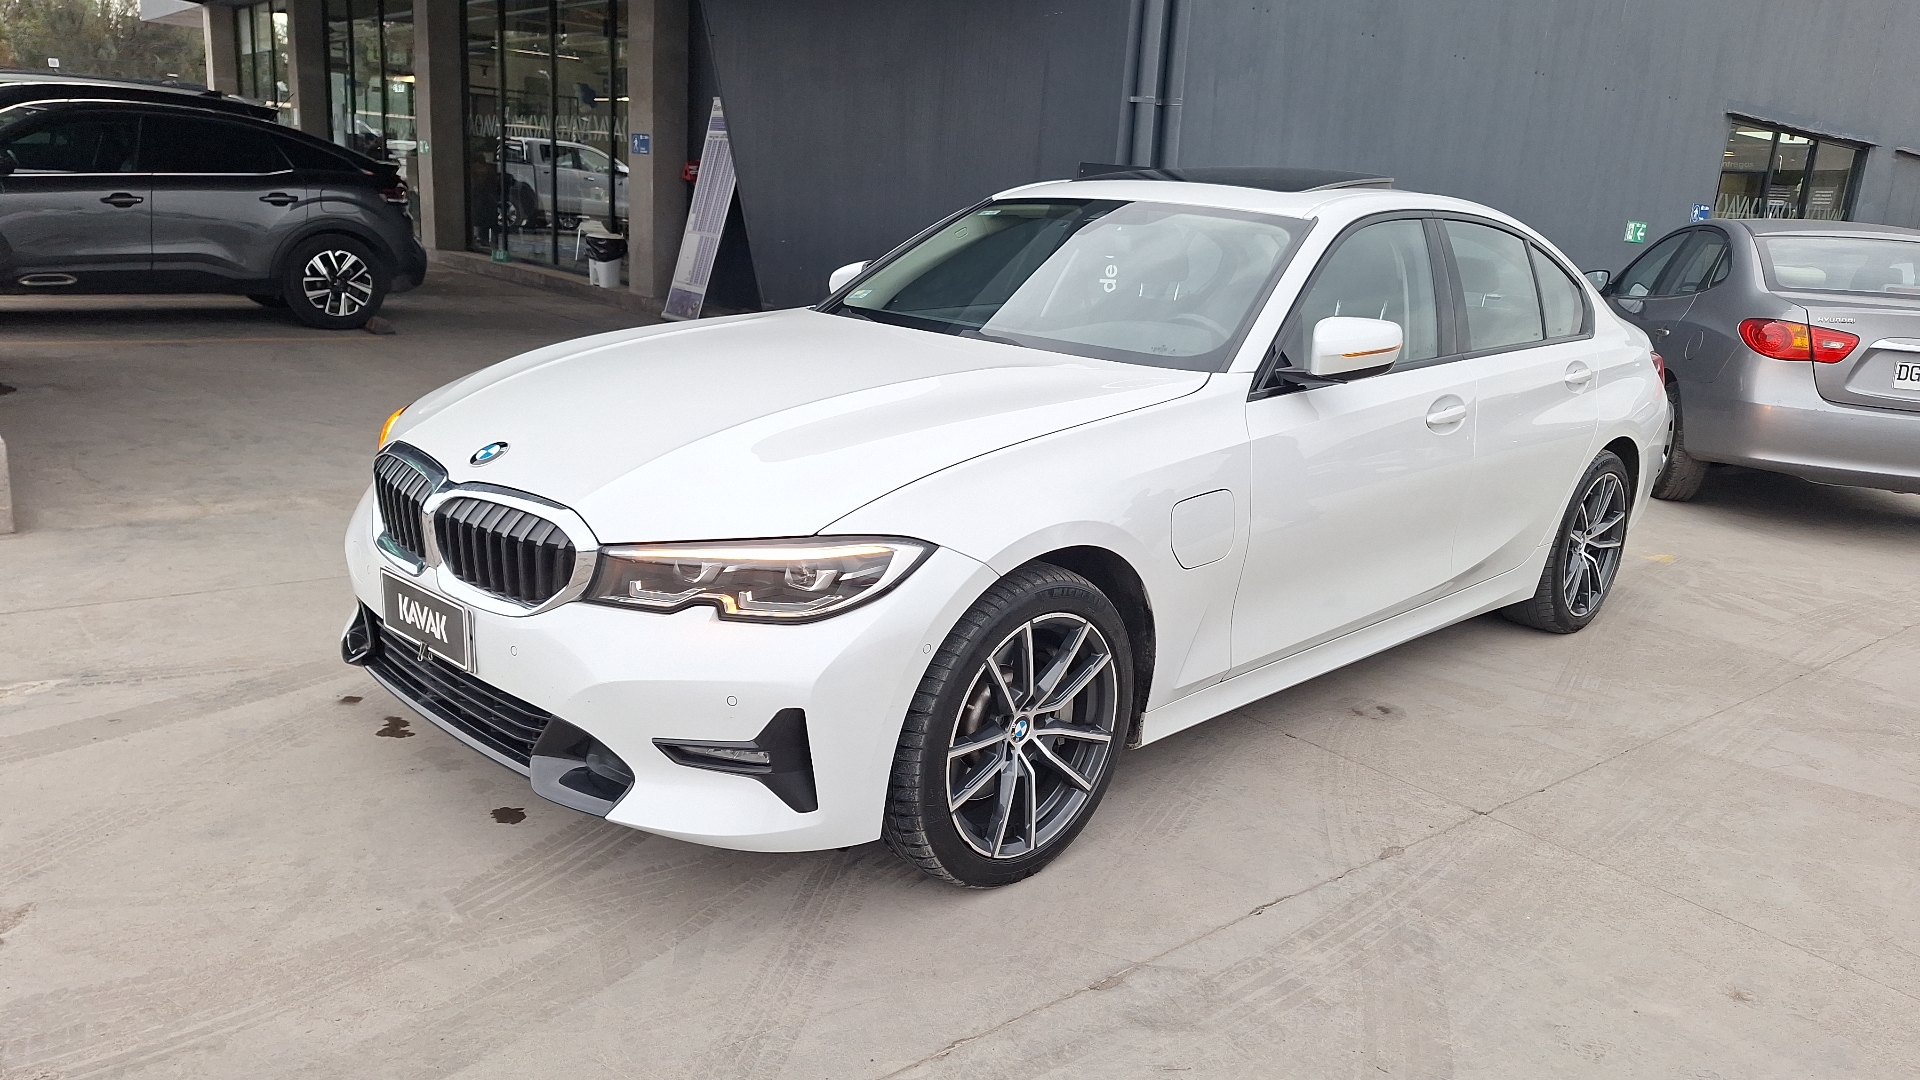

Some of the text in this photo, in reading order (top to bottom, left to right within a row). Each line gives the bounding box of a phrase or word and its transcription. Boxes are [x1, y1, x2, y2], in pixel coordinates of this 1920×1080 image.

[1722, 160, 1754, 169] ntregas
[1817, 316, 1856, 324] HYUNDAI
[1896, 364, 1920, 382] DG
[398, 592, 448, 644] KAVAK
